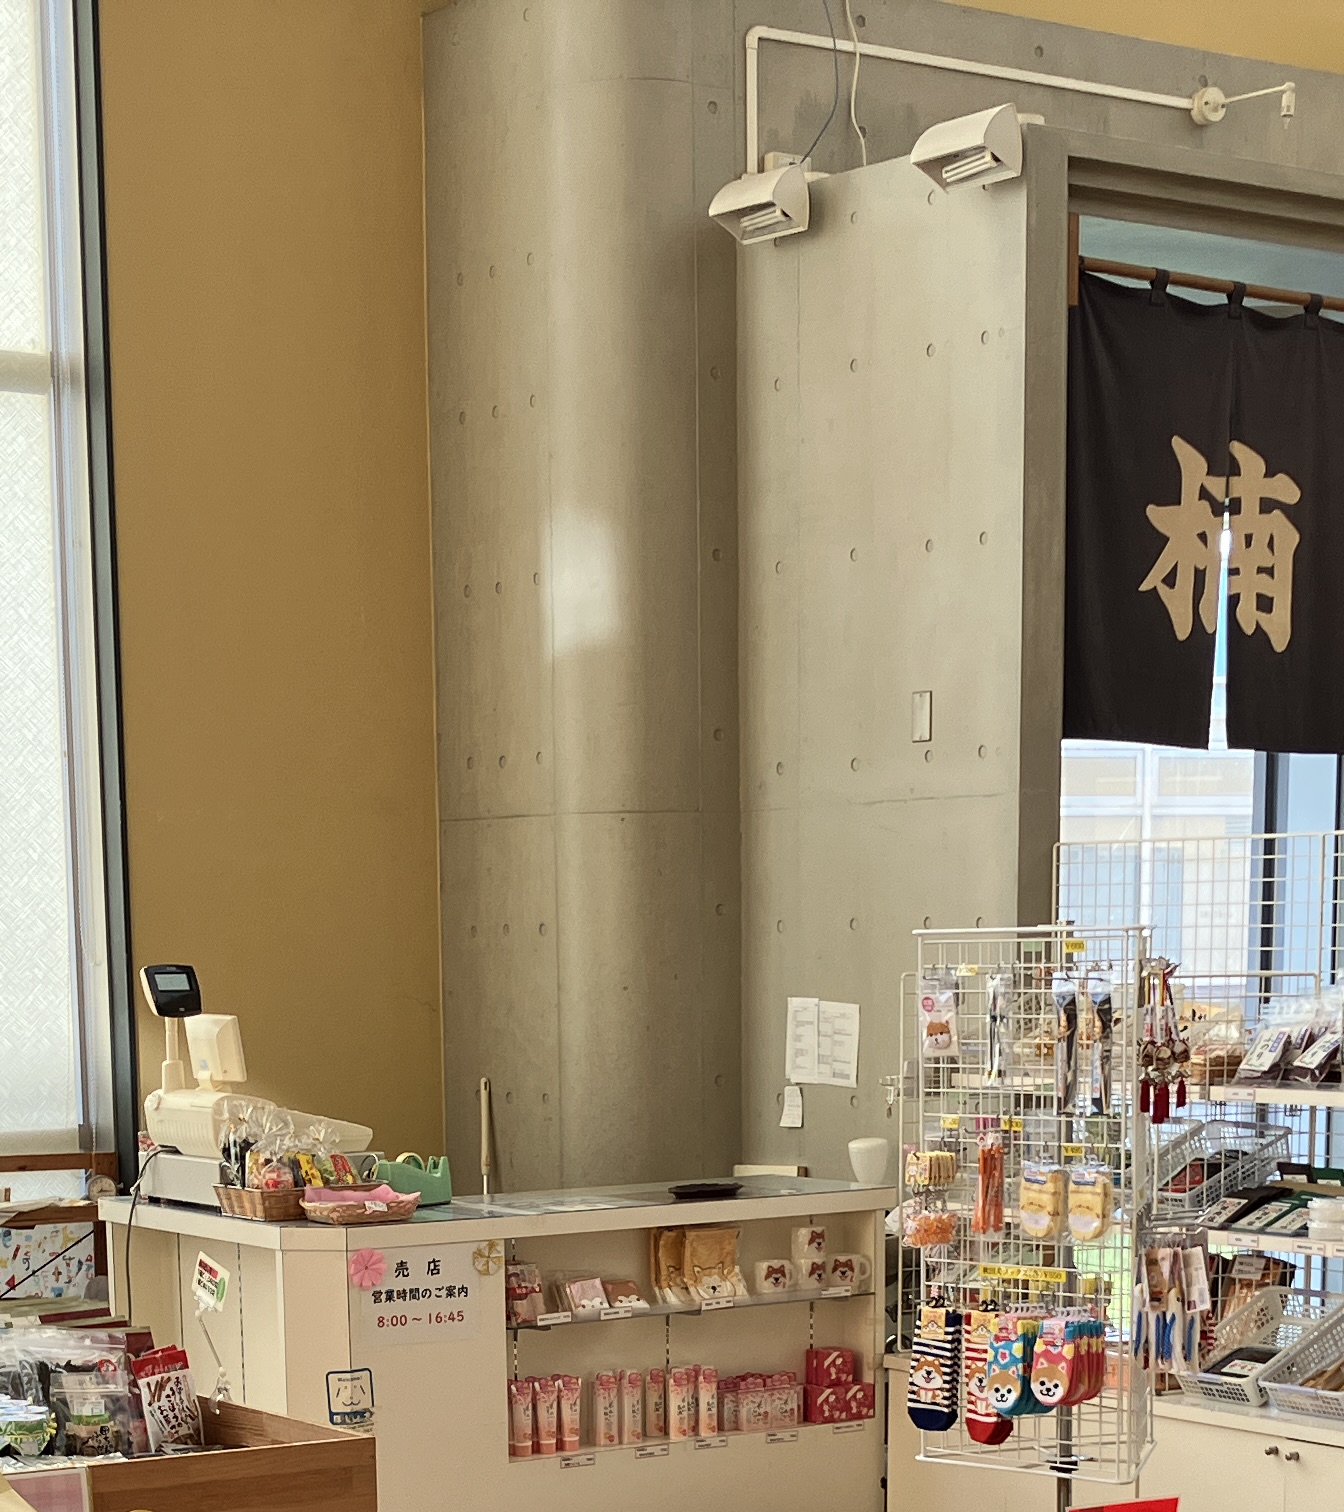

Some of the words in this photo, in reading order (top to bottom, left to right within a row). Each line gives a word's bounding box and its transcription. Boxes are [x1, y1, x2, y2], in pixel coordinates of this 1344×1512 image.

[372, 1284, 468, 1304] 営業時間のご案内
